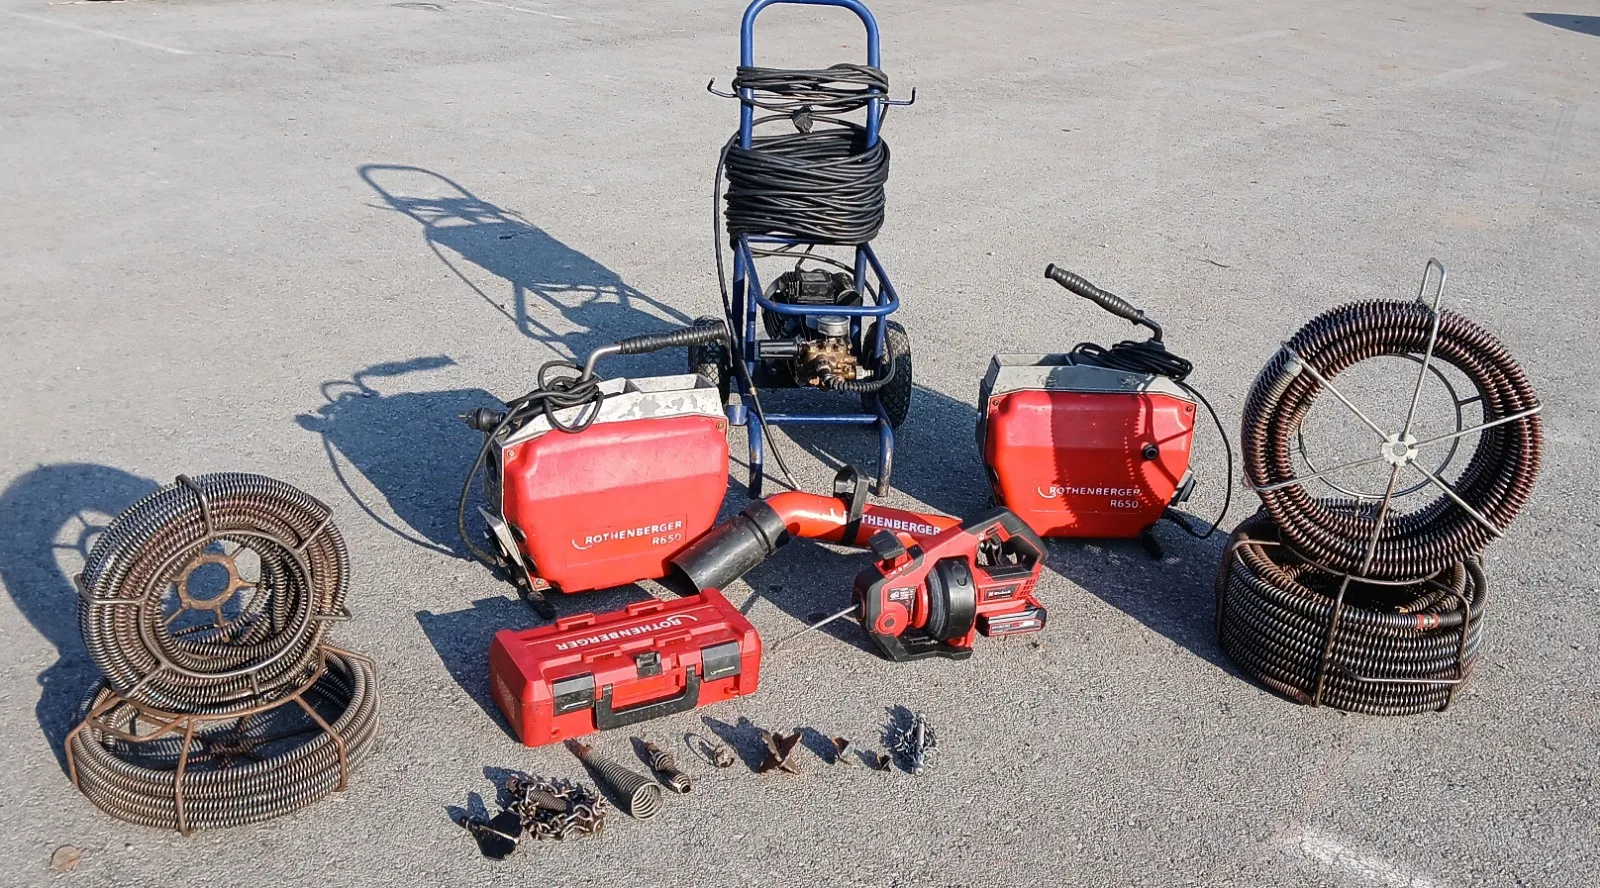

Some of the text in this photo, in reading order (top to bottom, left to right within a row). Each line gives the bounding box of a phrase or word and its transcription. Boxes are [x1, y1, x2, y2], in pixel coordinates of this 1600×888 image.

[1049, 486, 1141, 497] ROTHENBERGER
[1110, 499, 1139, 509] R650
[585, 520, 682, 545] ROTHENBERGER
[861, 514, 942, 536] THENBERGER
[652, 532, 682, 546] R650
[556, 617, 682, 650] ROTHENBERGER
